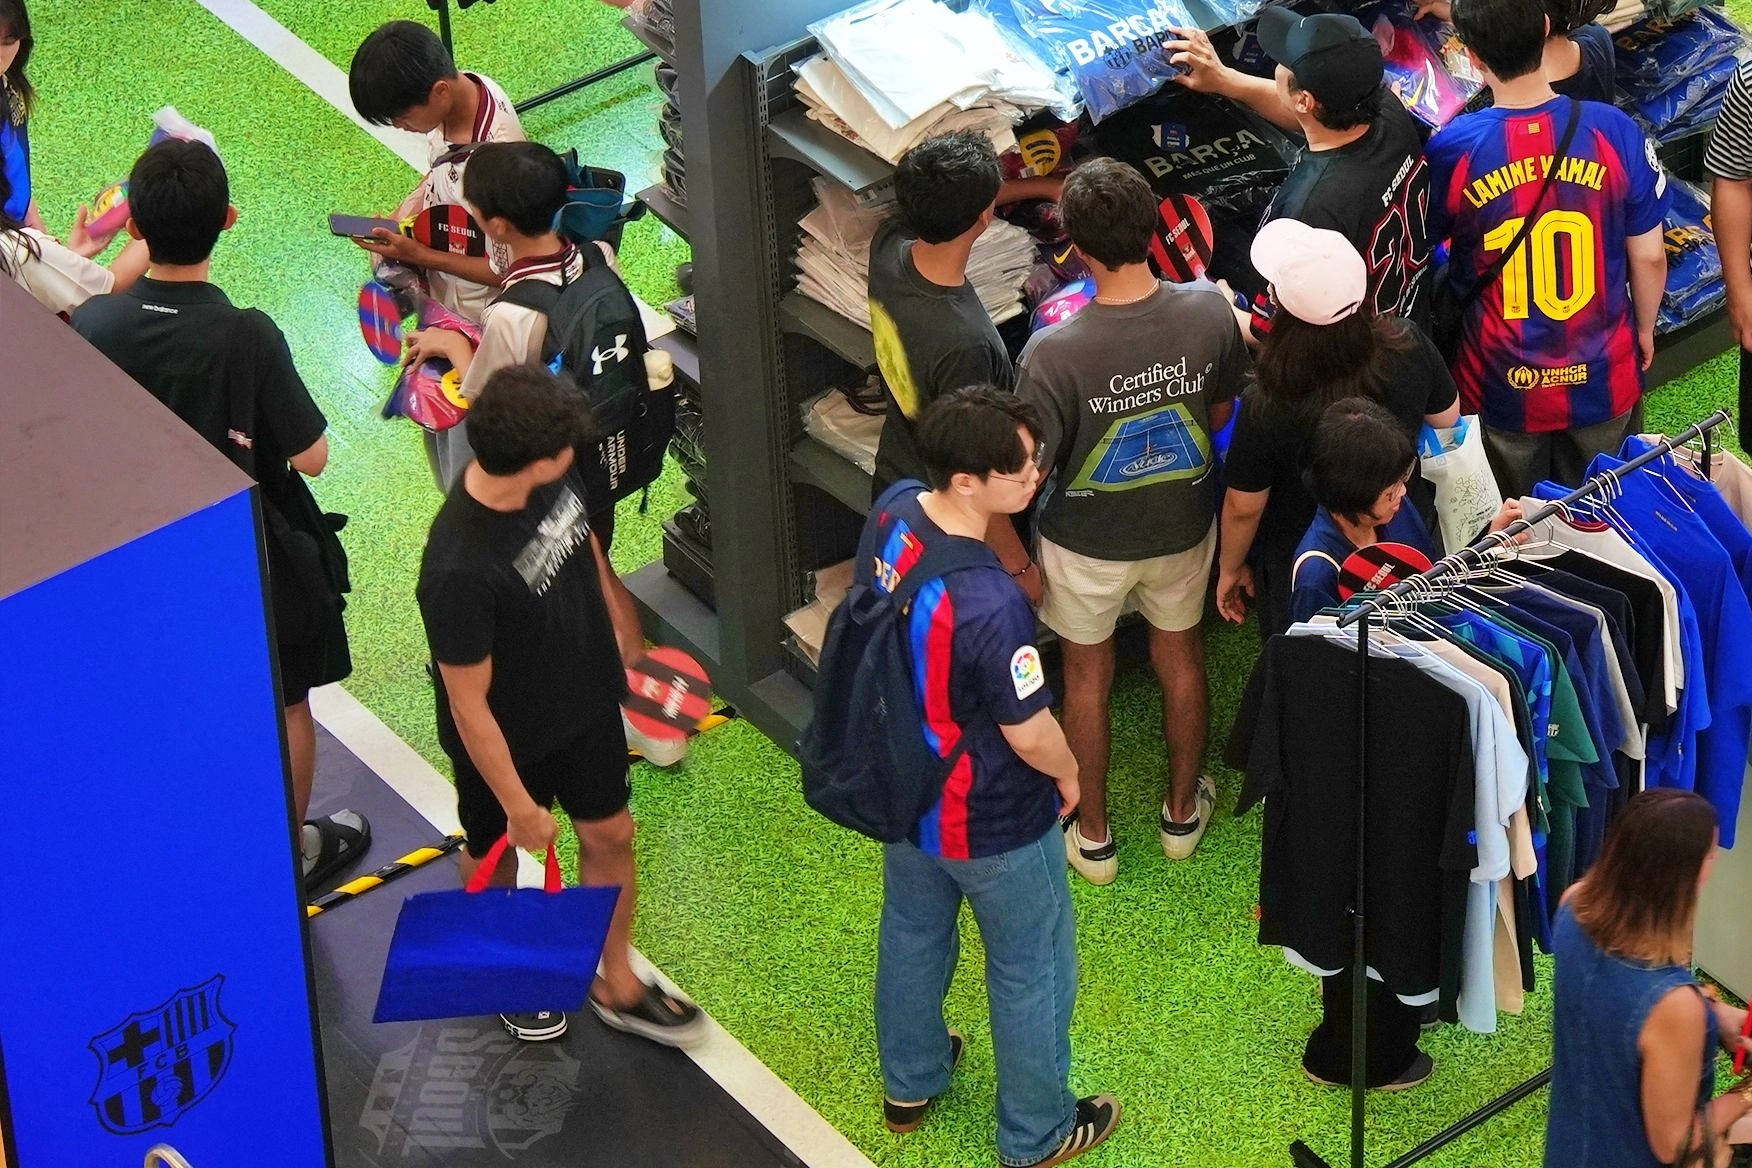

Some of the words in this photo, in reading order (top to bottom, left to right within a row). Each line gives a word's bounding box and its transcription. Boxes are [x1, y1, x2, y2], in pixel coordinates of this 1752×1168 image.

[1132, 32, 1172, 56] BAR
[1382, 186, 1394, 208] FC
[1392, 154, 1414, 191] SEOUL
[1462, 156, 1538, 210] LAMINE
[1542, 156, 1609, 192] YAMAL
[438, 223, 449, 234] FC
[450, 224, 478, 239] SEOUL
[1165, 231, 1175, 245] FC
[1173, 217, 1191, 239] SEOUL
[1484, 209, 1597, 321] 10
[1109, 356, 1187, 396] Certified
[1541, 364, 1587, 376] UNHCR
[1542, 371, 1587, 384] ACNUR
[1088, 385, 1162, 416] Winners
[1165, 373, 1205, 399] Club
[606, 435, 619, 491] ARMOUR
[616, 429, 627, 475] UNDER
[1374, 562, 1396, 585] SEOUL
[136, 1043, 190, 1080] FCB
